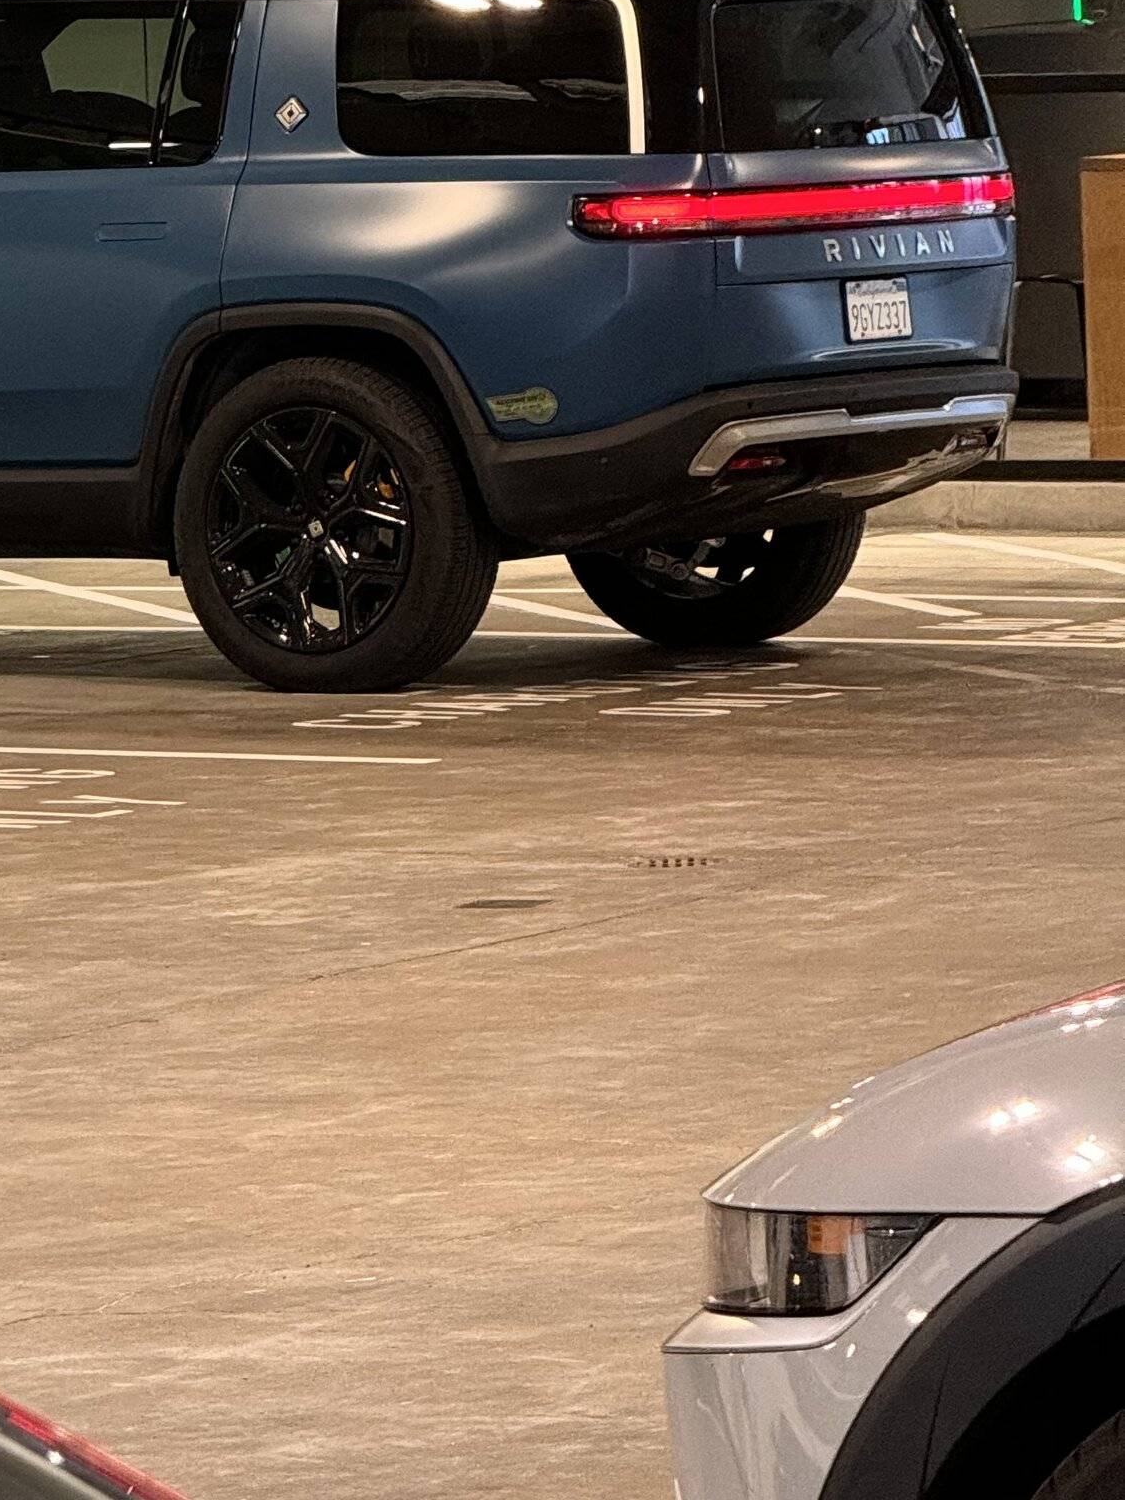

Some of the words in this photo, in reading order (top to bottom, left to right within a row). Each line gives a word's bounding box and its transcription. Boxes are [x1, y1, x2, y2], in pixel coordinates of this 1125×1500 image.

[823, 229, 955, 262] RIVIAN
[851, 301, 907, 332] 9GYZ337
[292, 661, 800, 729] CHARGING
[598, 683, 883, 717] ONLY
